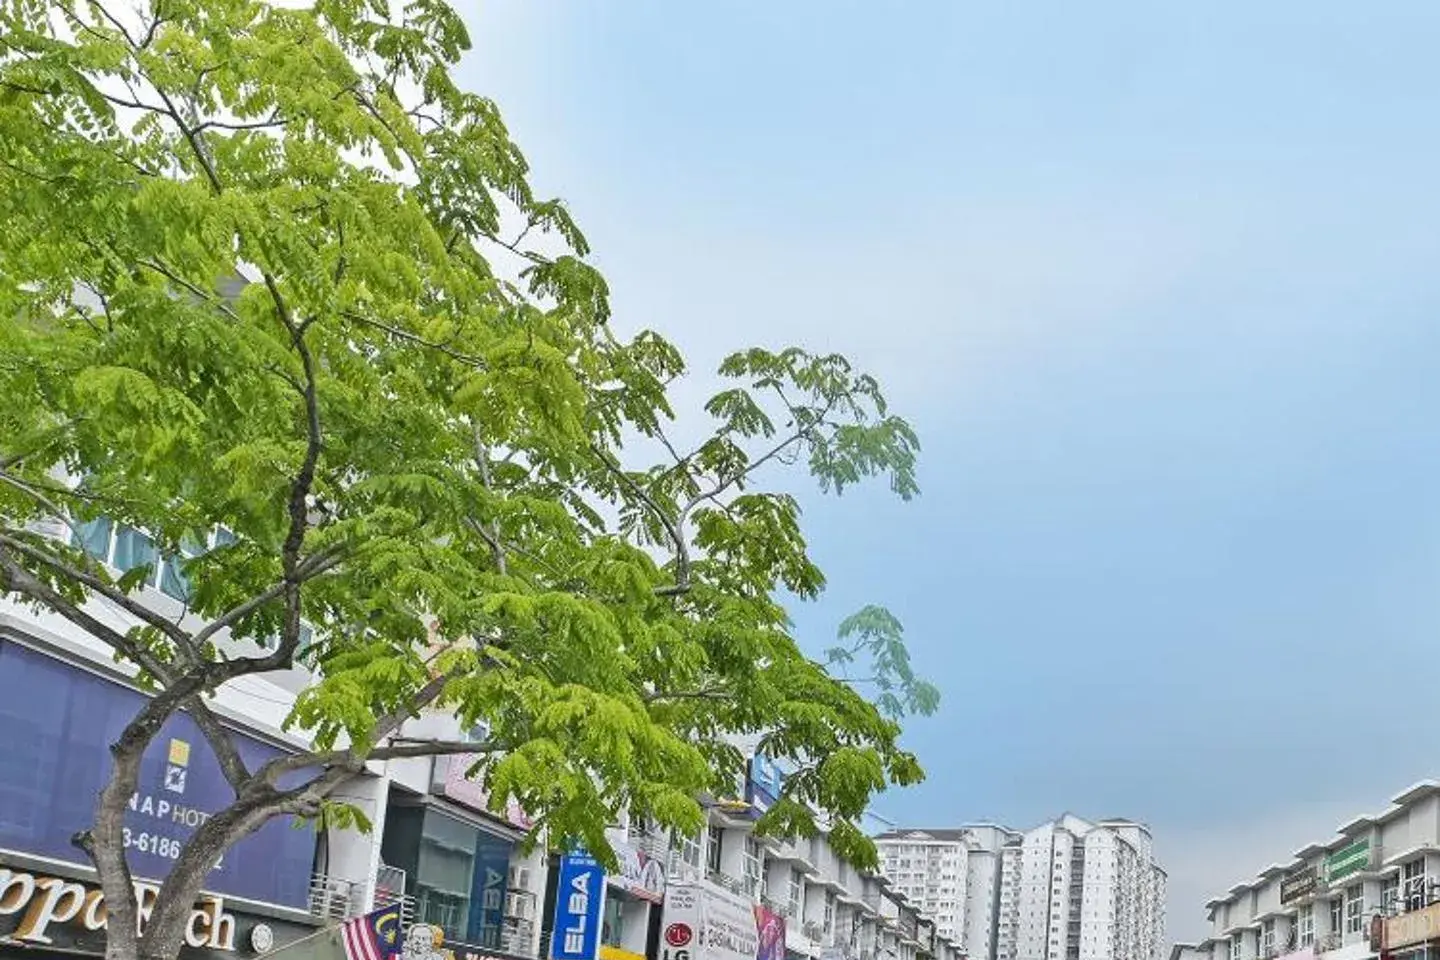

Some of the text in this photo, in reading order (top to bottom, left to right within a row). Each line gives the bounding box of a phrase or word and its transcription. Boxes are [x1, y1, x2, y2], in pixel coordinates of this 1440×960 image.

[128, 793, 212, 827] NAP HOT
[121, 827, 181, 860] 3-6186
[563, 870, 592, 954] ELBA
